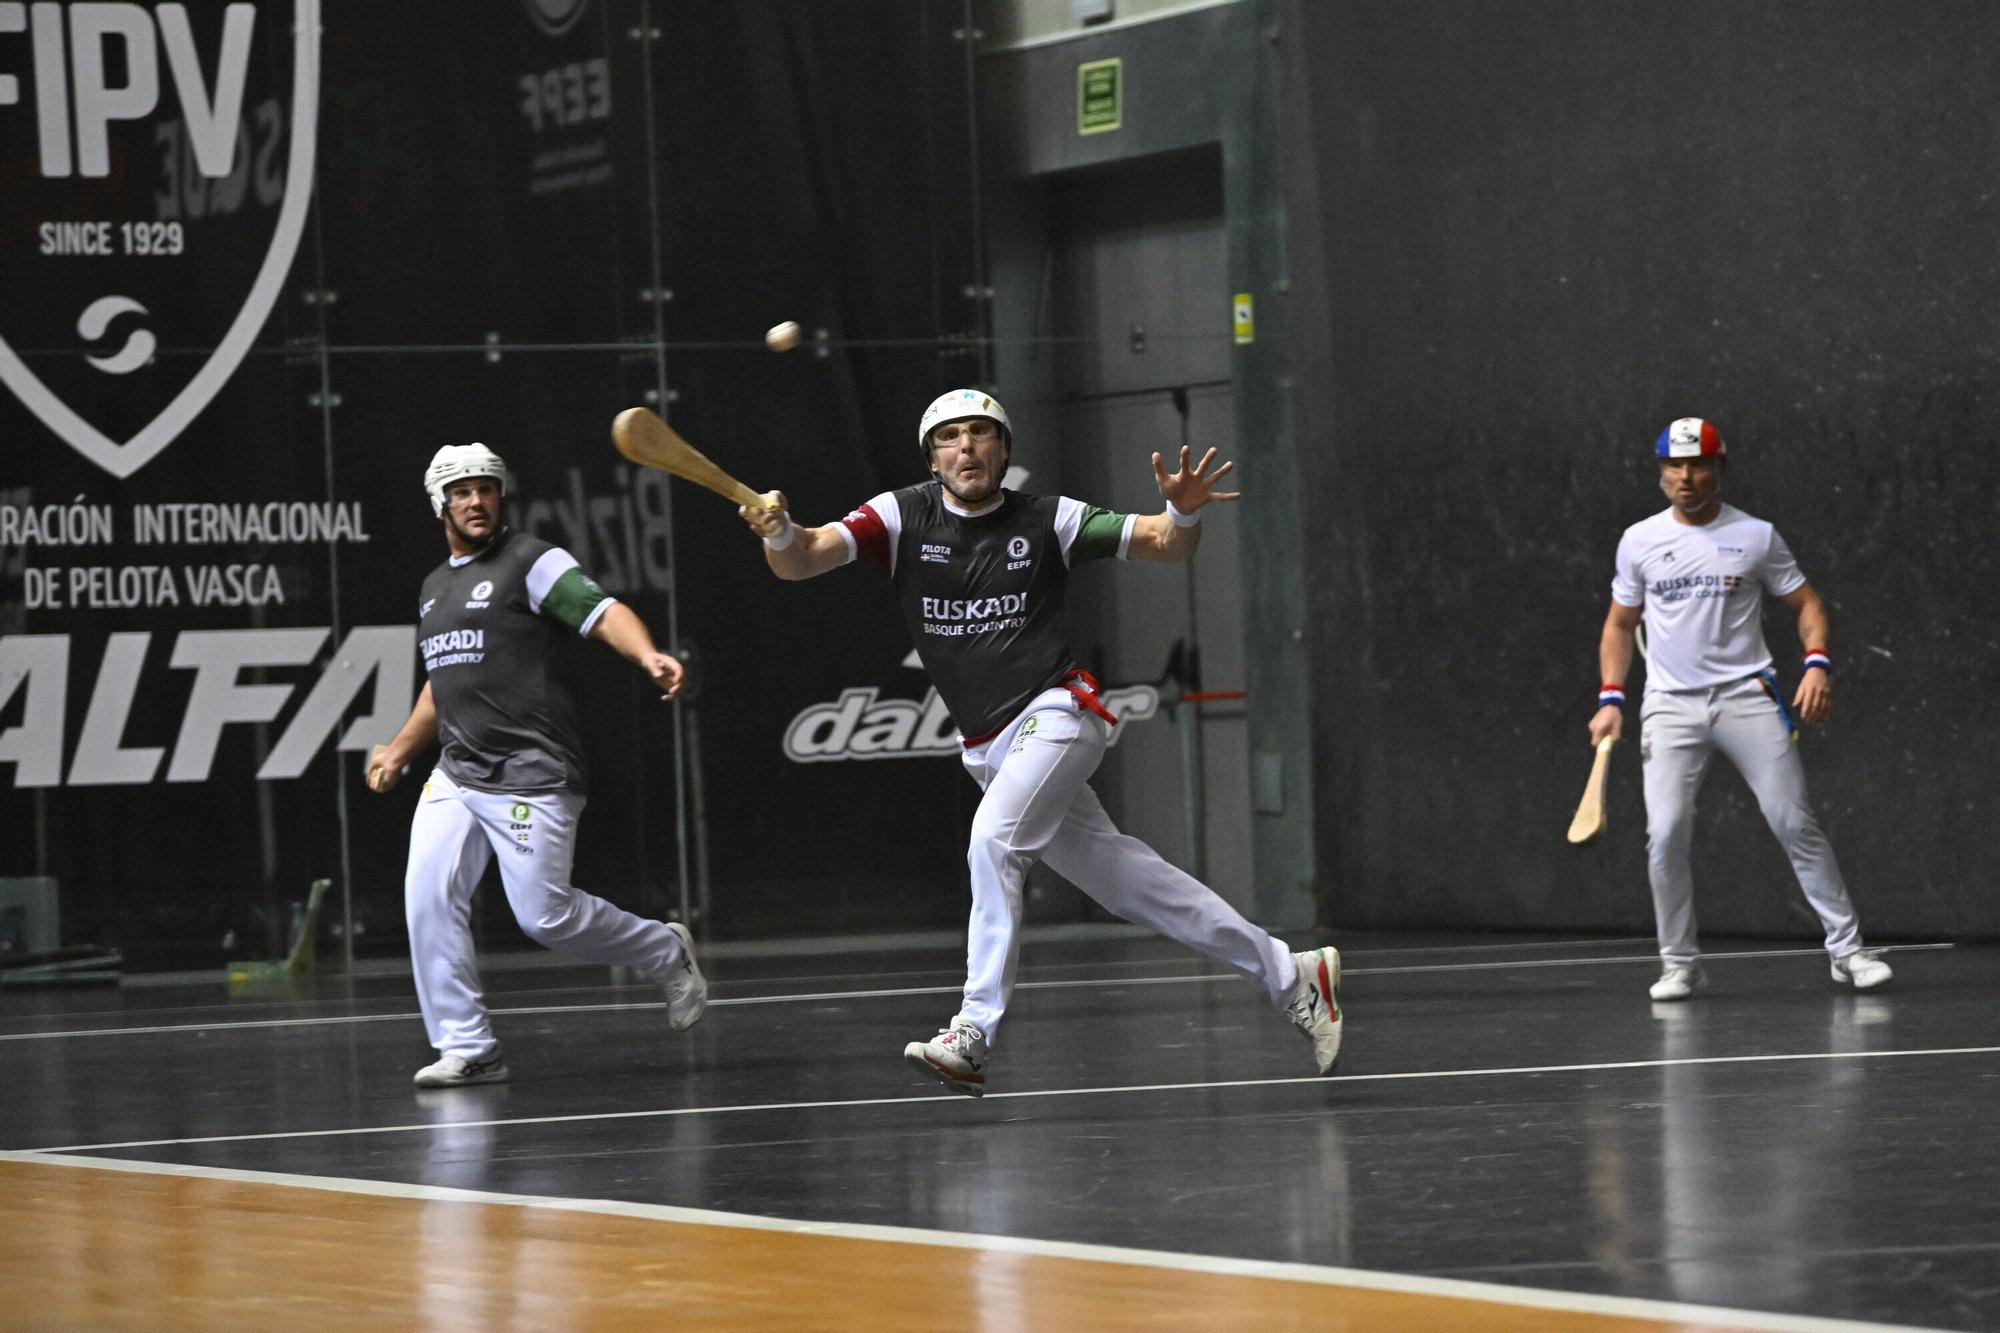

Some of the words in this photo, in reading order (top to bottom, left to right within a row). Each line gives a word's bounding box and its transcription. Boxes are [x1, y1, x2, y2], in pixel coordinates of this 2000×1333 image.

[39, 222, 112, 255] SINCE
[121, 222, 184, 255] 1929
[133, 500, 370, 544] INTERNACIONAL
[1007, 559, 1032, 571] EEPF
[25, 567, 60, 609] DE
[70, 564, 178, 608] PELOTA
[185, 563, 284, 605] VASCA
[922, 592, 1028, 620] EUSKADI
[923, 622, 964, 636] BASQUE
[967, 616, 1026, 634] COUNTRY
[420, 629, 484, 659] USKADI
[0, 624, 417, 788] ALFA
[783, 686, 1157, 762] dabr
